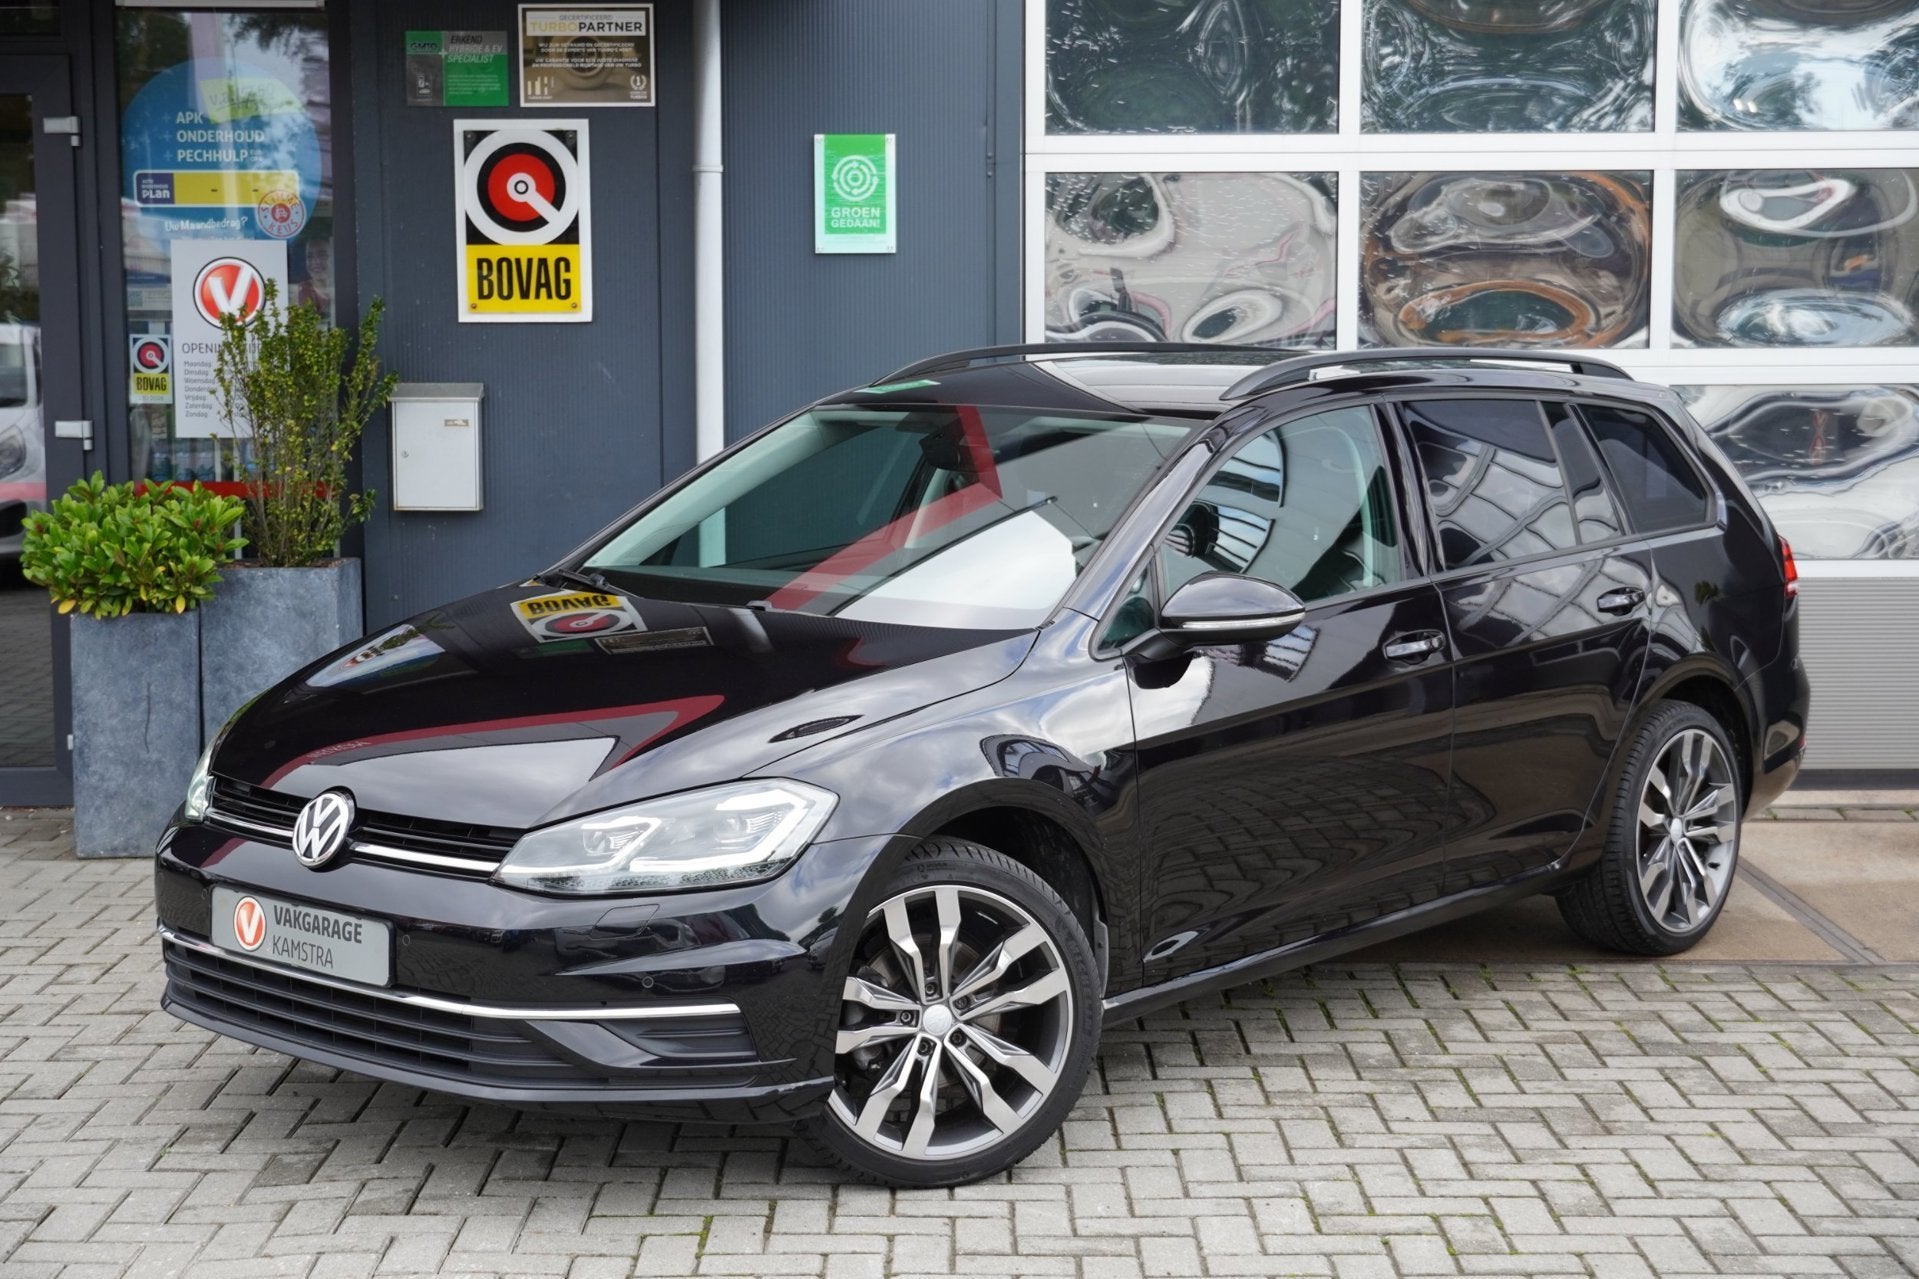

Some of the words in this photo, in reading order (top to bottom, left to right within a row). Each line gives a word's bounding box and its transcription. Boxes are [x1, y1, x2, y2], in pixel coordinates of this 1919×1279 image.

[531, 21, 643, 33] TURBOPARTNER
[450, 34, 483, 44] ERKEND
[447, 54, 494, 63] SPECIALIST
[176, 111, 204, 125] APK
[176, 130, 265, 143] ONDERHOUD
[177, 149, 249, 162] PECHHULP
[831, 207, 880, 218] GROEN
[831, 219, 880, 228] GEDAAN!
[476, 256, 572, 300] BOVAG
[136, 377, 167, 391] BOVAG
[273, 904, 363, 944] VAKGARAGE
[272, 934, 334, 969] KAMSTRA
